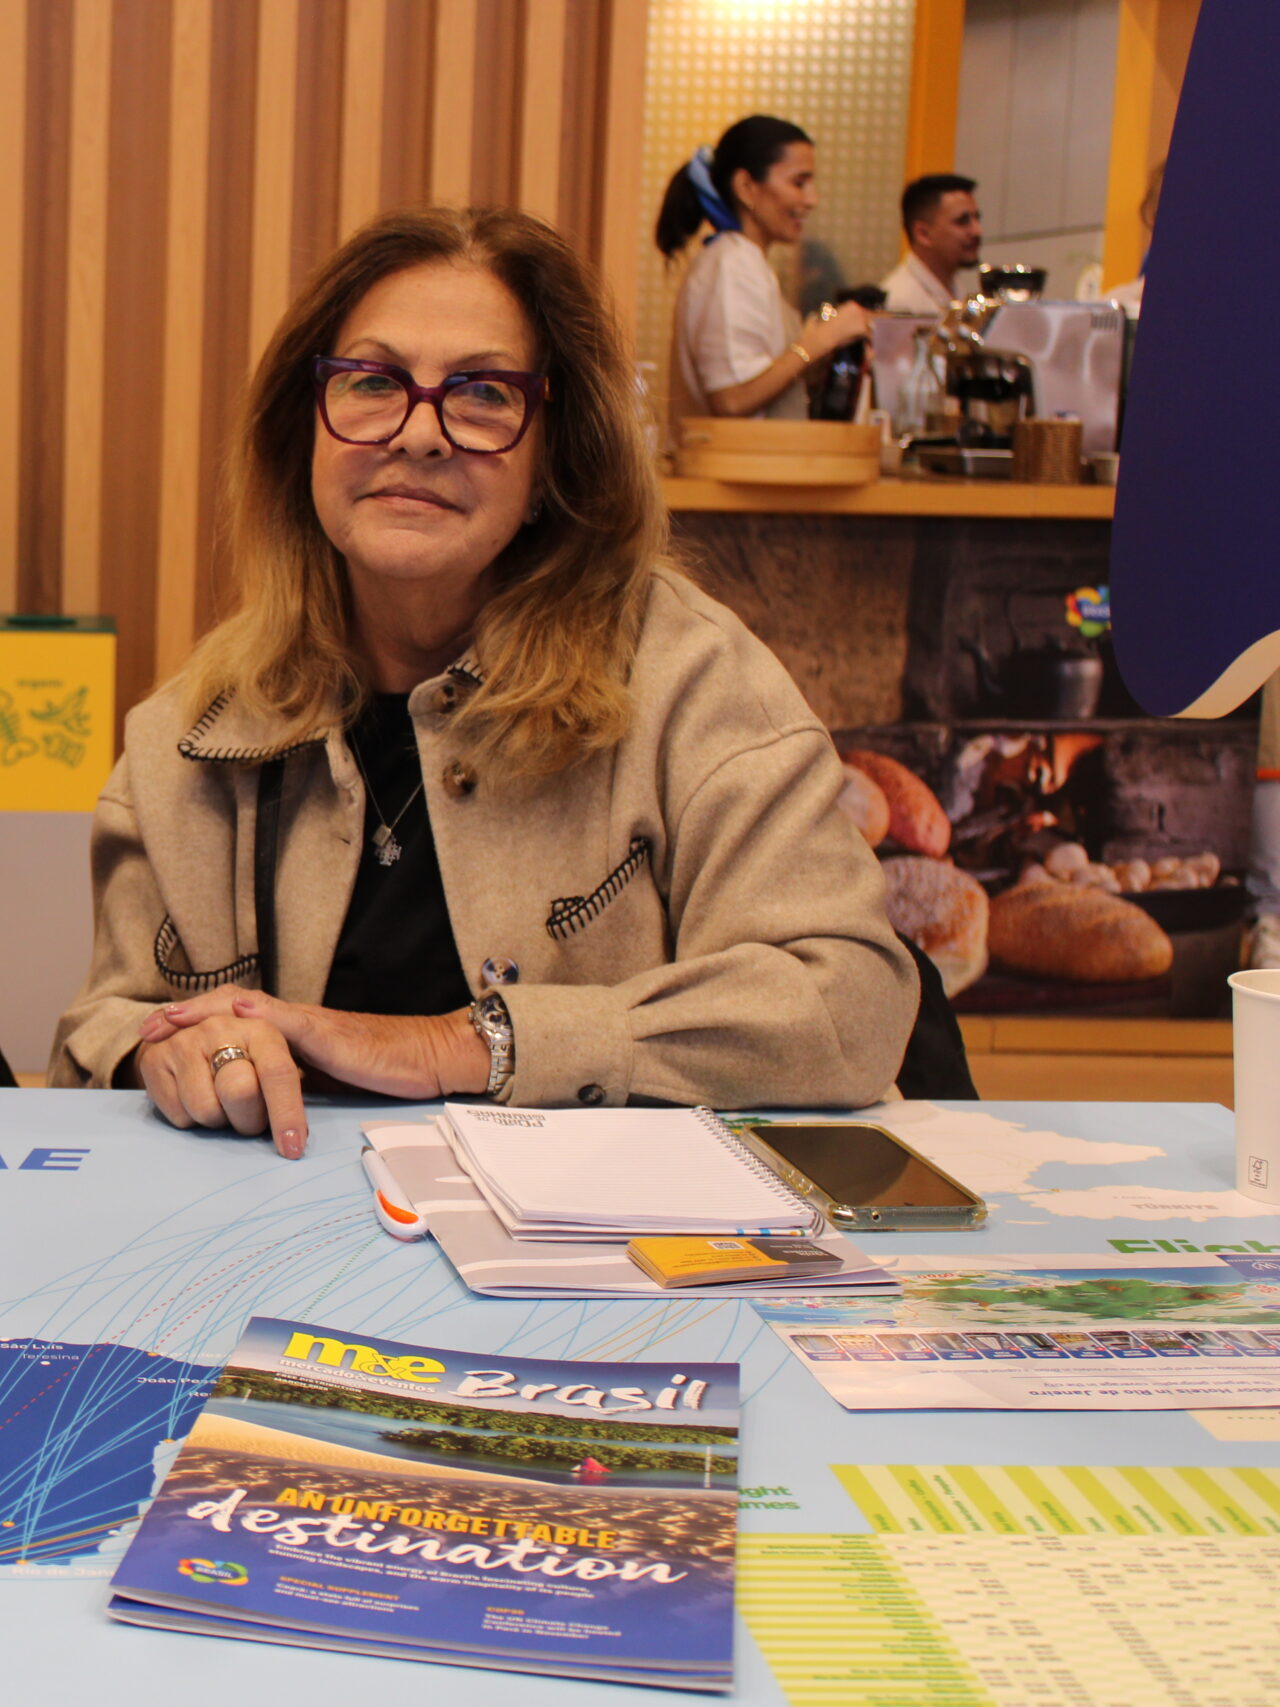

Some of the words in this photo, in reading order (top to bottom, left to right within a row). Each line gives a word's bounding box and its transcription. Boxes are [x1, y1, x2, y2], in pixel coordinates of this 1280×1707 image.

[0, 1342, 29, 1350] São
[32, 1342, 64, 1350] Luís
[137, 1376, 177, 1384] João
[449, 1368, 711, 1415] Brasil
[185, 1488, 689, 1584] destination
[274, 1486, 325, 1511] AN
[331, 1492, 620, 1550] UNFORGETTABLE
